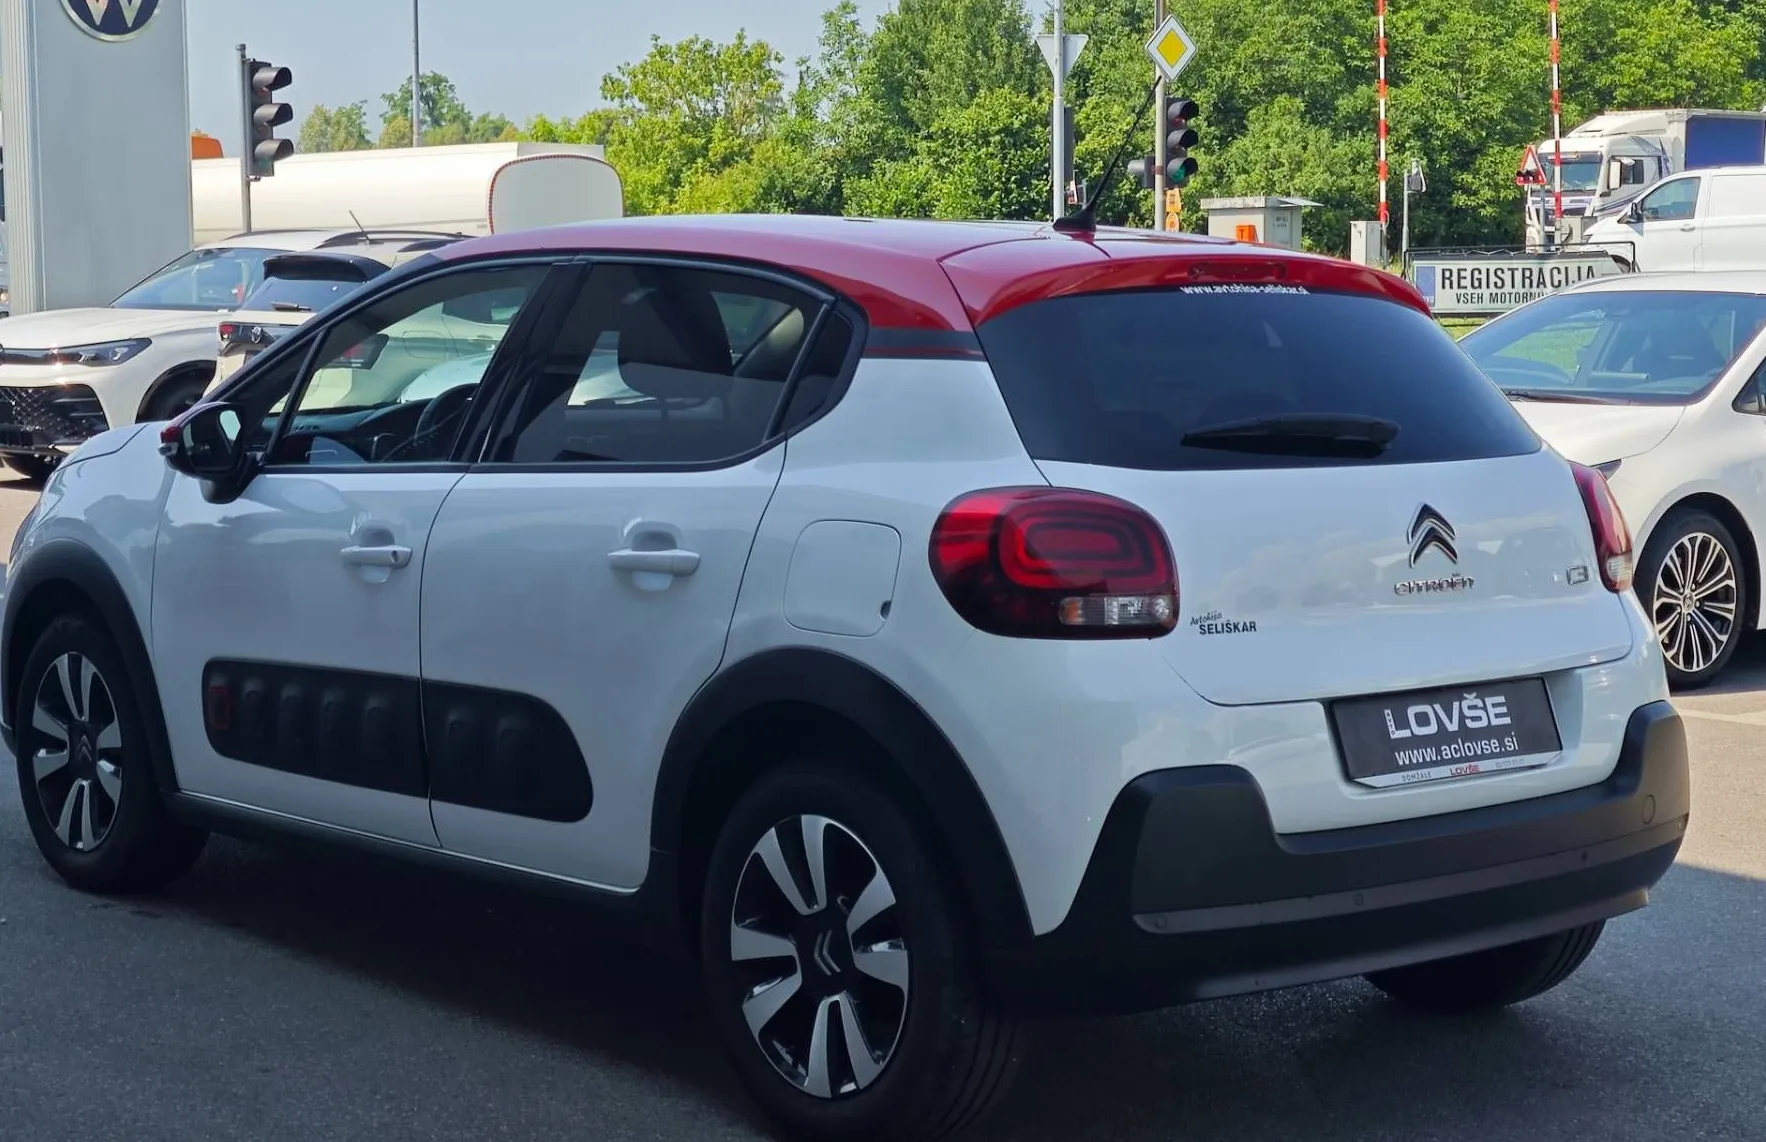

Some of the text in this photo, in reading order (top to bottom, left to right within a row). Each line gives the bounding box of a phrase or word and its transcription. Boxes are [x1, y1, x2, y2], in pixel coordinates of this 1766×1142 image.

[1441, 265, 1595, 290] REGISTRACIJA
[1456, 292, 1484, 305] VSEH
[1394, 572, 1475, 595] CITROËN
[1566, 565, 1589, 585] C3
[1199, 620, 1257, 635] SELIŠKAR
[1384, 692, 1512, 739] LOVŠE
[1395, 732, 1518, 766] www.aclovse.si
